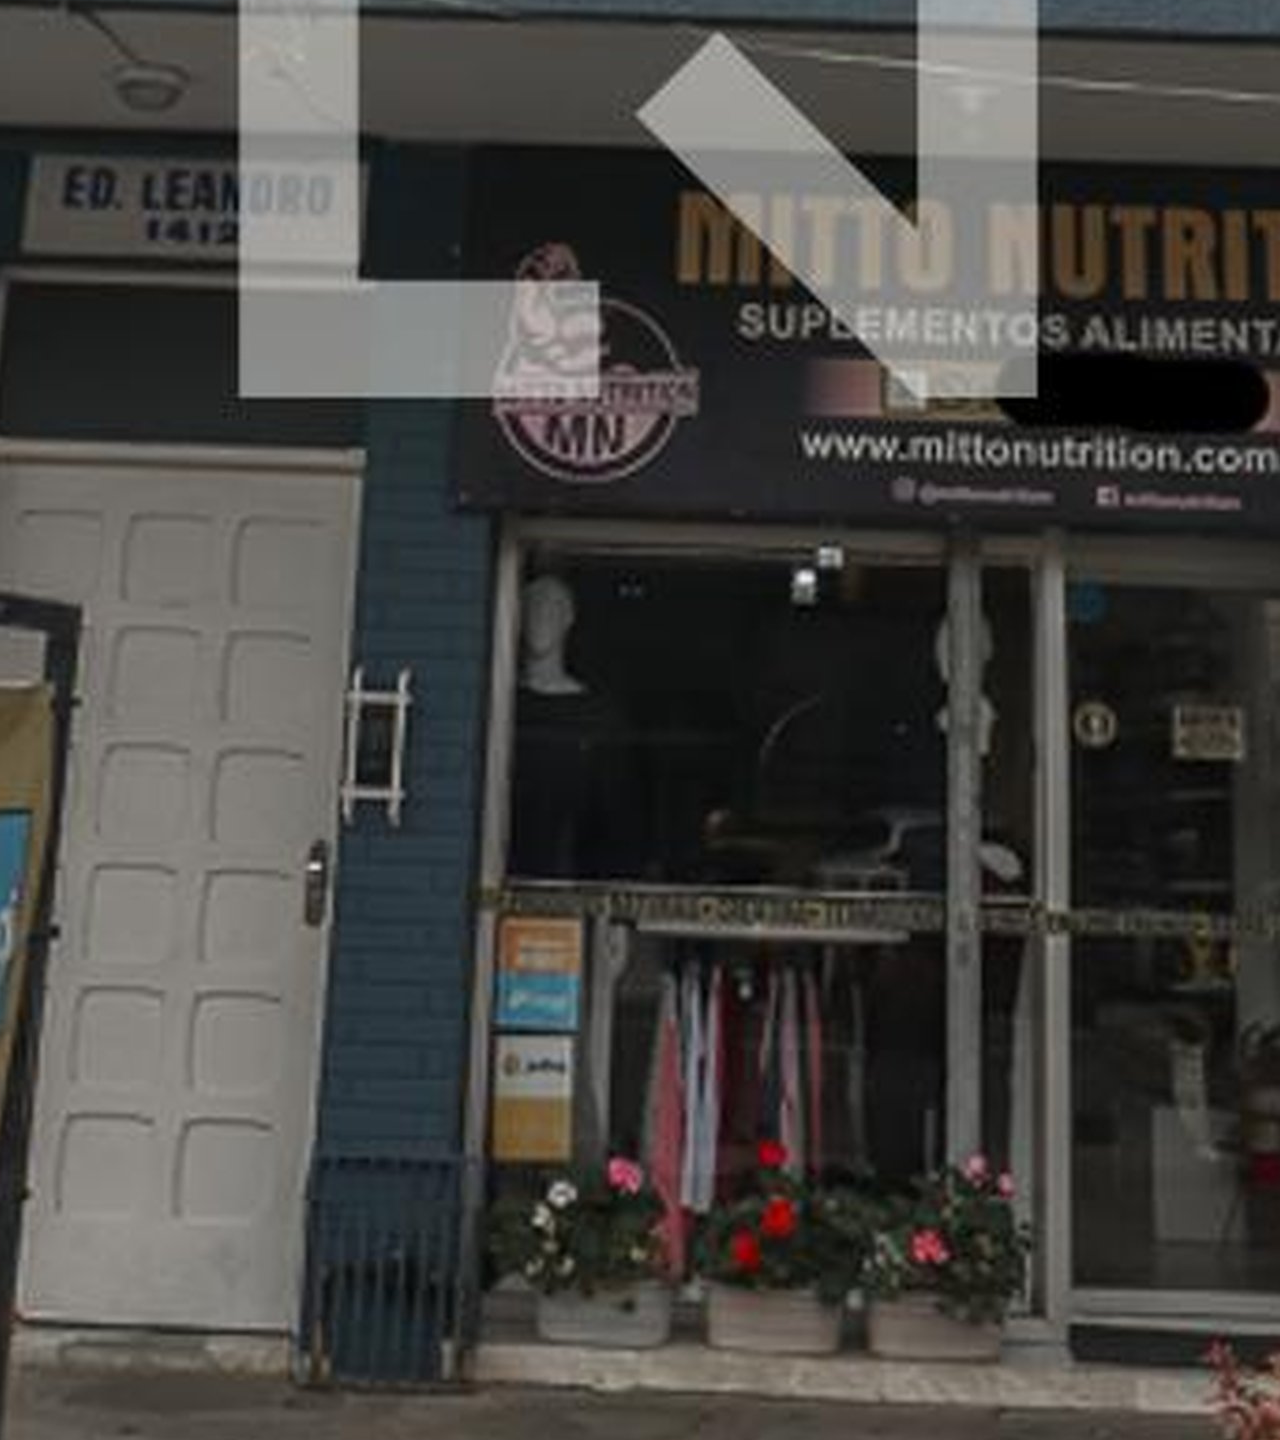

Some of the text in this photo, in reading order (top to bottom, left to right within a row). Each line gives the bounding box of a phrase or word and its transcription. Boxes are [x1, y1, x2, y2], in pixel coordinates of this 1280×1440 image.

[64, 165, 335, 216] ED. LEANDRO
[675, 189, 955, 294] MITTO
[736, 302, 1070, 349] SUPLEMENTOS
